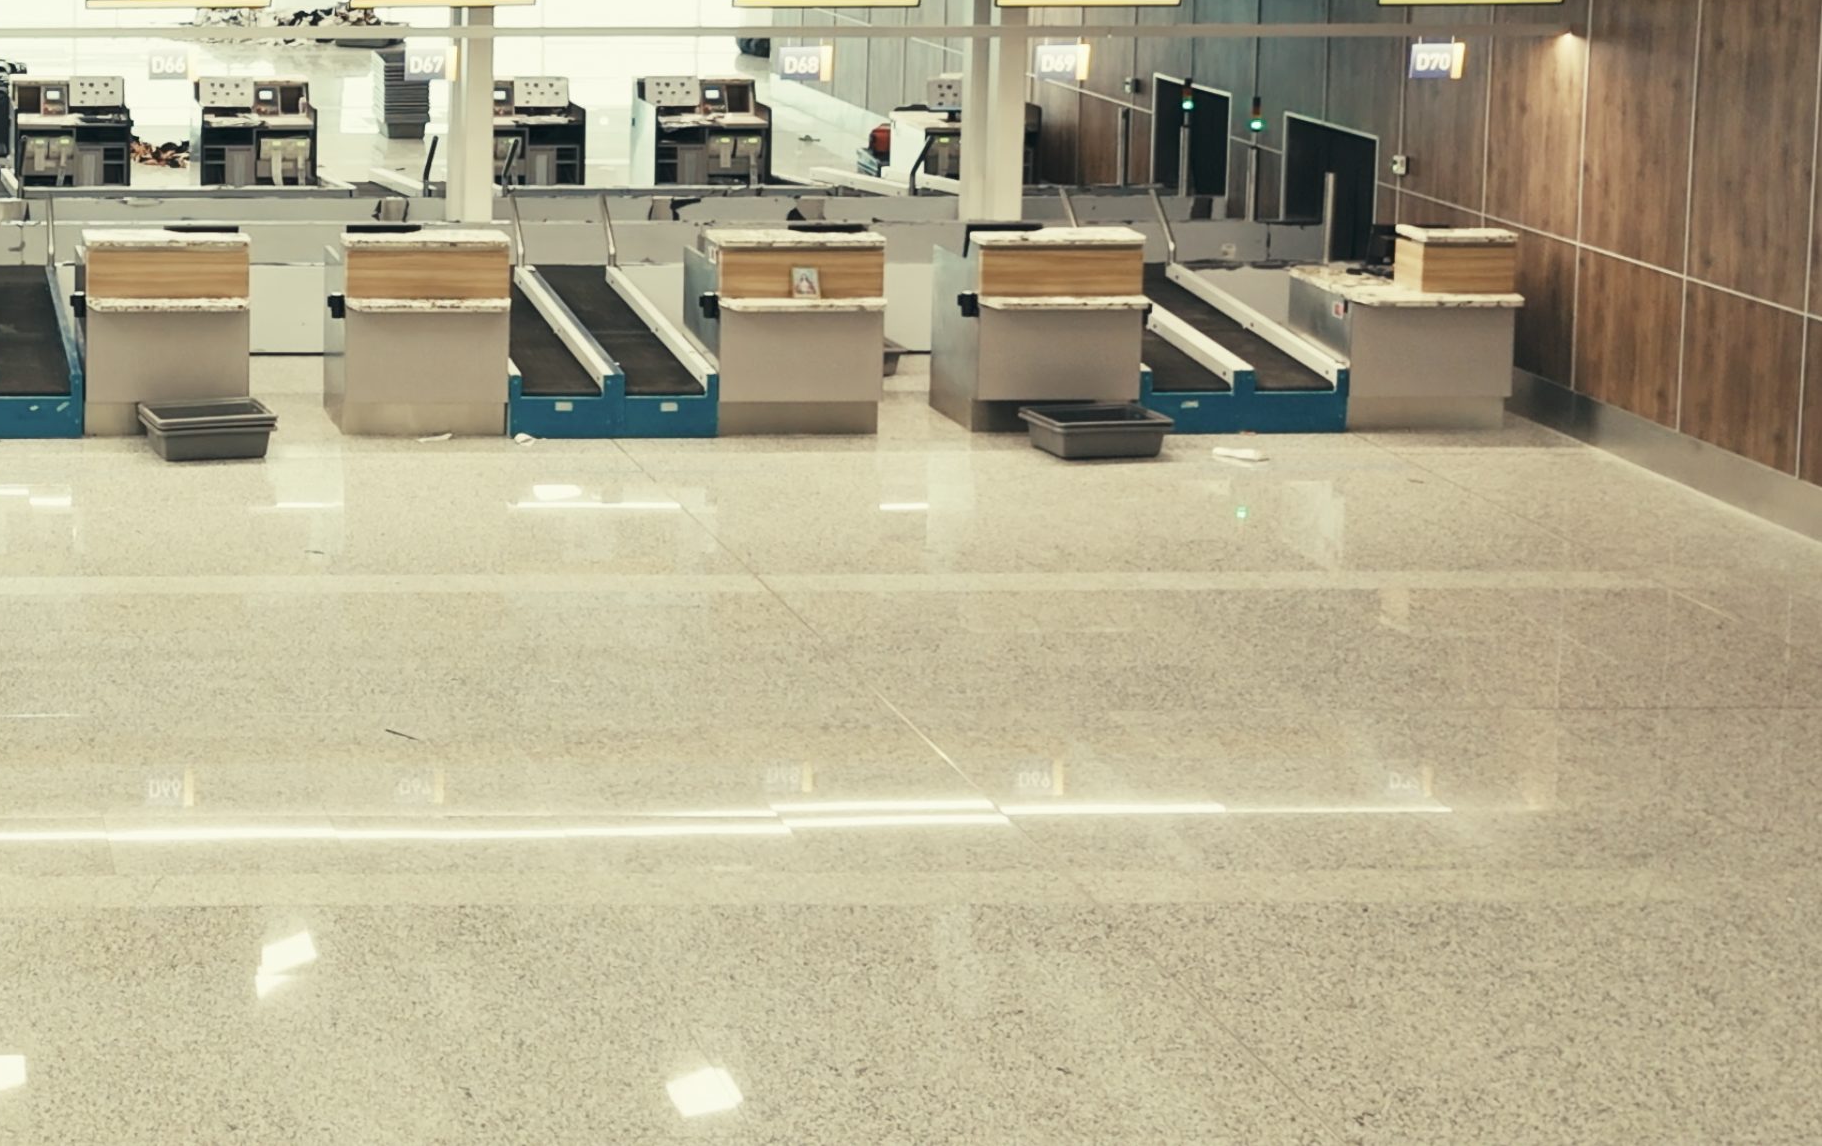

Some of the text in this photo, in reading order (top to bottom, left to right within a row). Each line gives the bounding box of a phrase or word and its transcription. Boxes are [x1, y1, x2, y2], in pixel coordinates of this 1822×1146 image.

[151, 56, 186, 74] D66
[409, 56, 444, 74] D67
[784, 56, 819, 74] D68
[1041, 54, 1076, 73] D69
[1415, 53, 1451, 71] D70
